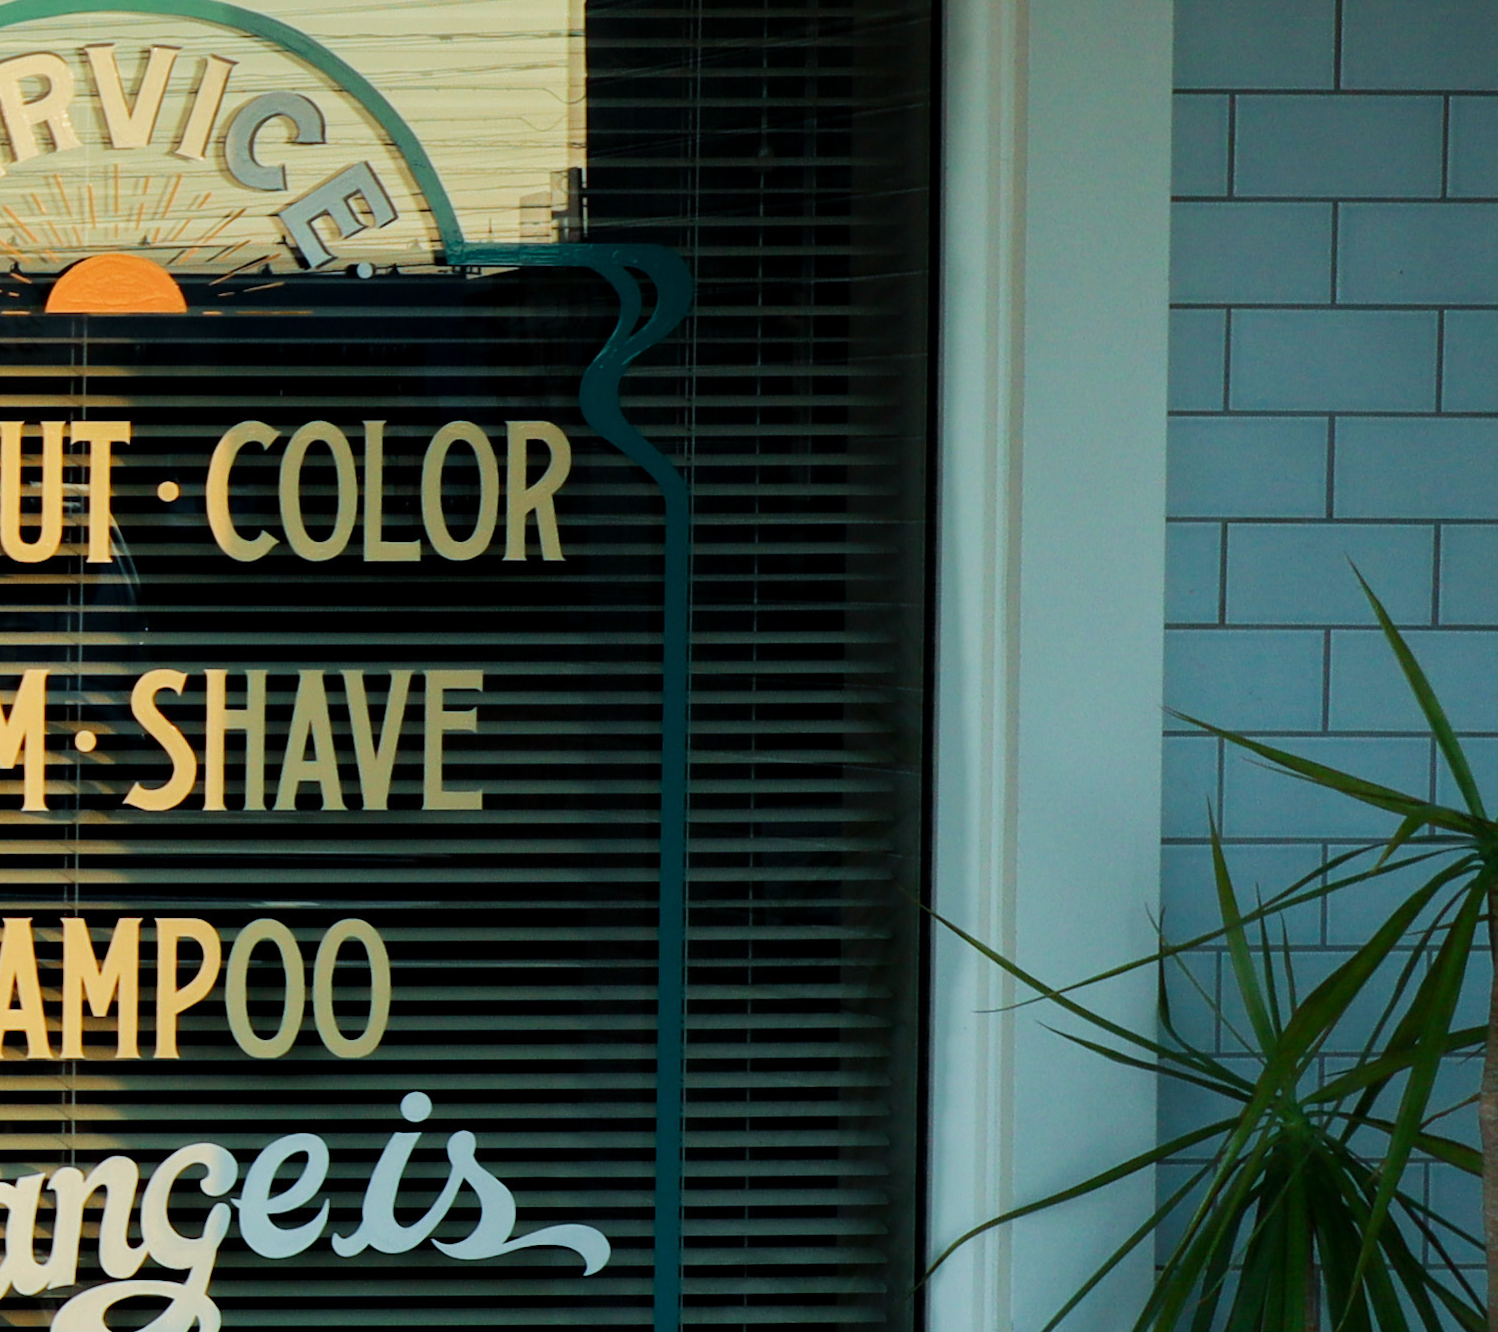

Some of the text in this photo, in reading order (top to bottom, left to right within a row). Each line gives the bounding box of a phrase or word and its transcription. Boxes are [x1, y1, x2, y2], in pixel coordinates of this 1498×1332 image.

[204, 419, 572, 563] COLOR
[121, 668, 485, 812] SHAVE
[330, 1091, 611, 1277] is
